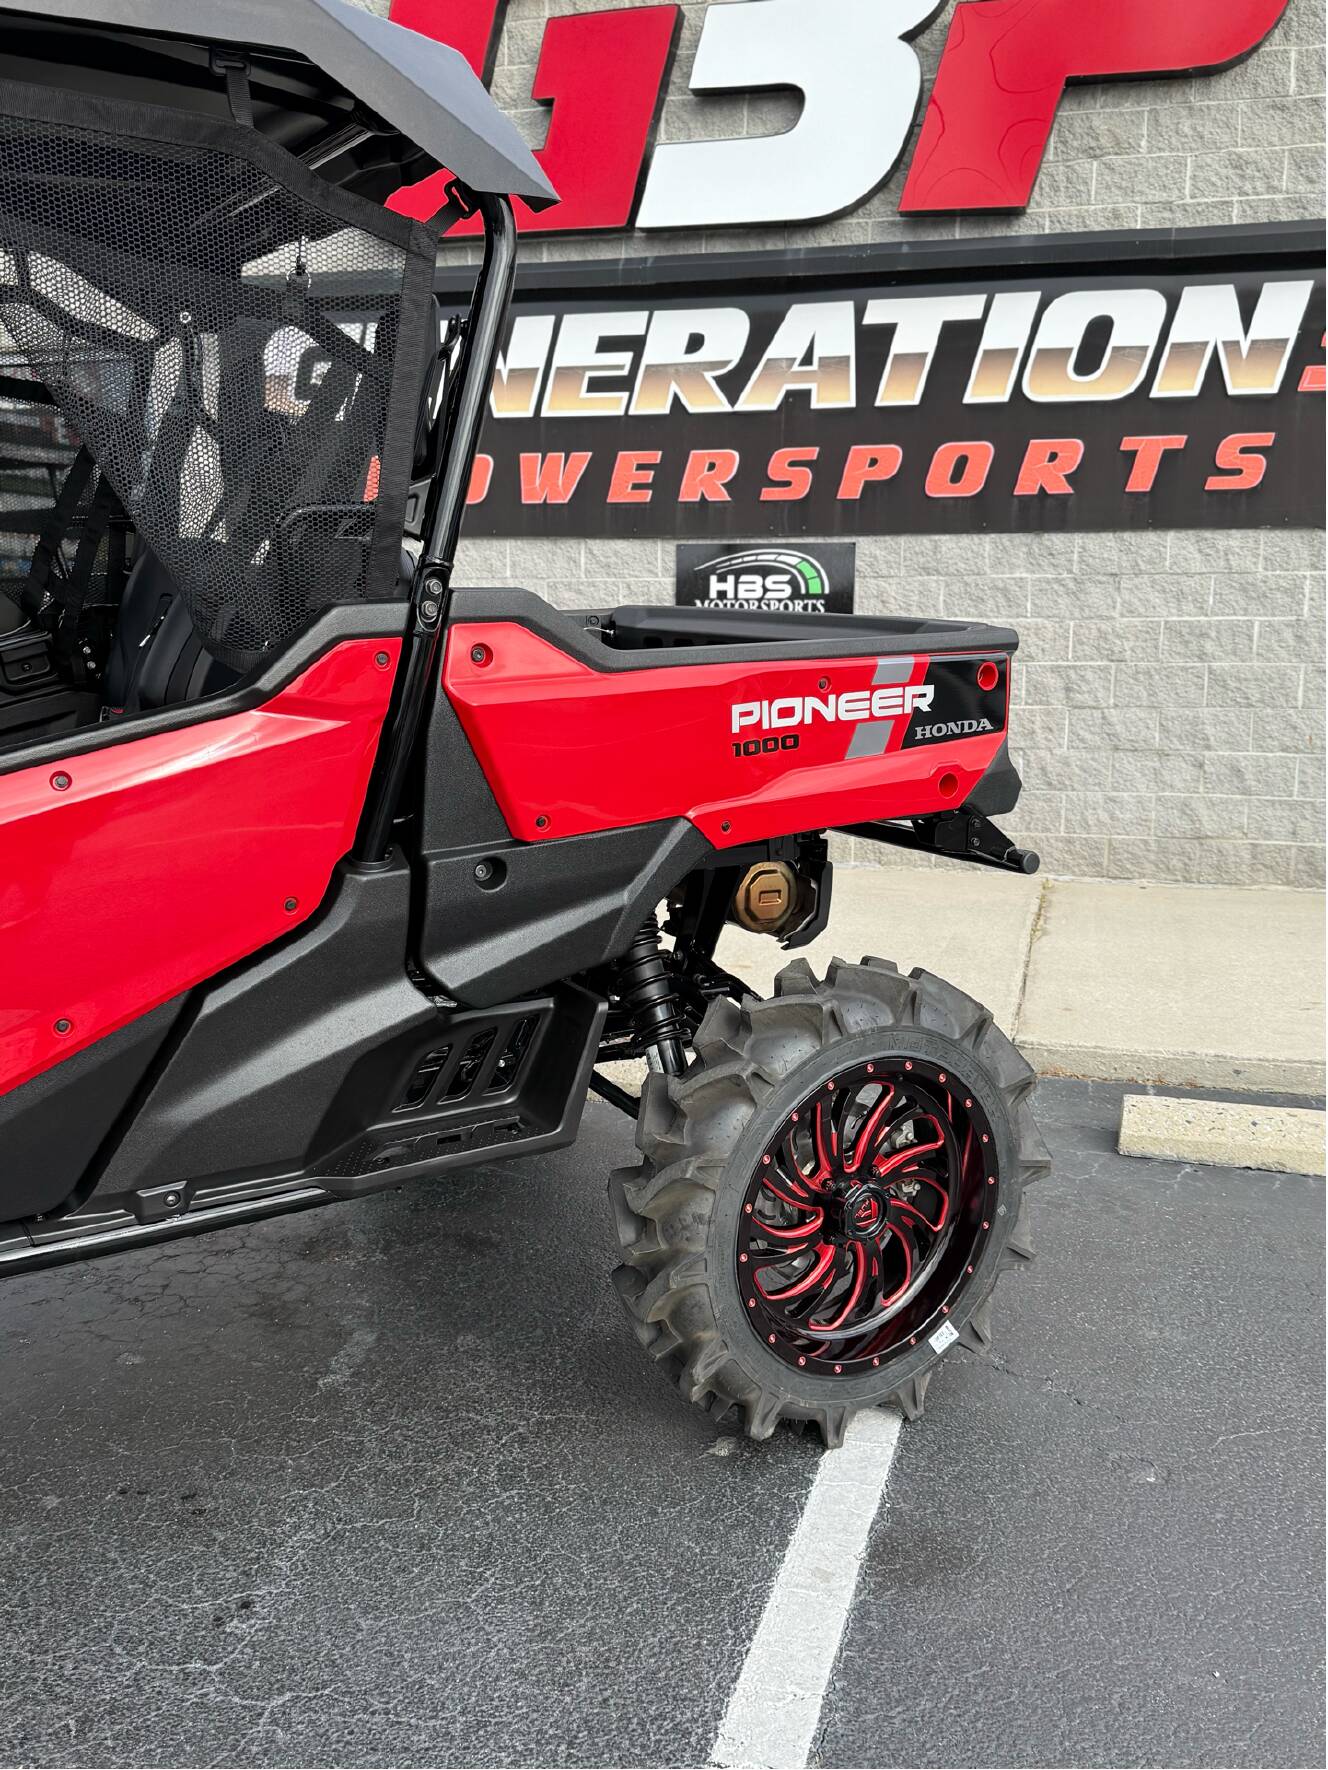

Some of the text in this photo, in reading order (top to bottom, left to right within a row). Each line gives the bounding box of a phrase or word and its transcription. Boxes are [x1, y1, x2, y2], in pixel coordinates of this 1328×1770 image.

[709, 574, 792, 599] HBS
[731, 684, 935, 734] PIONEER
[914, 718, 994, 740] HONDA
[732, 734, 800, 758] 1000
